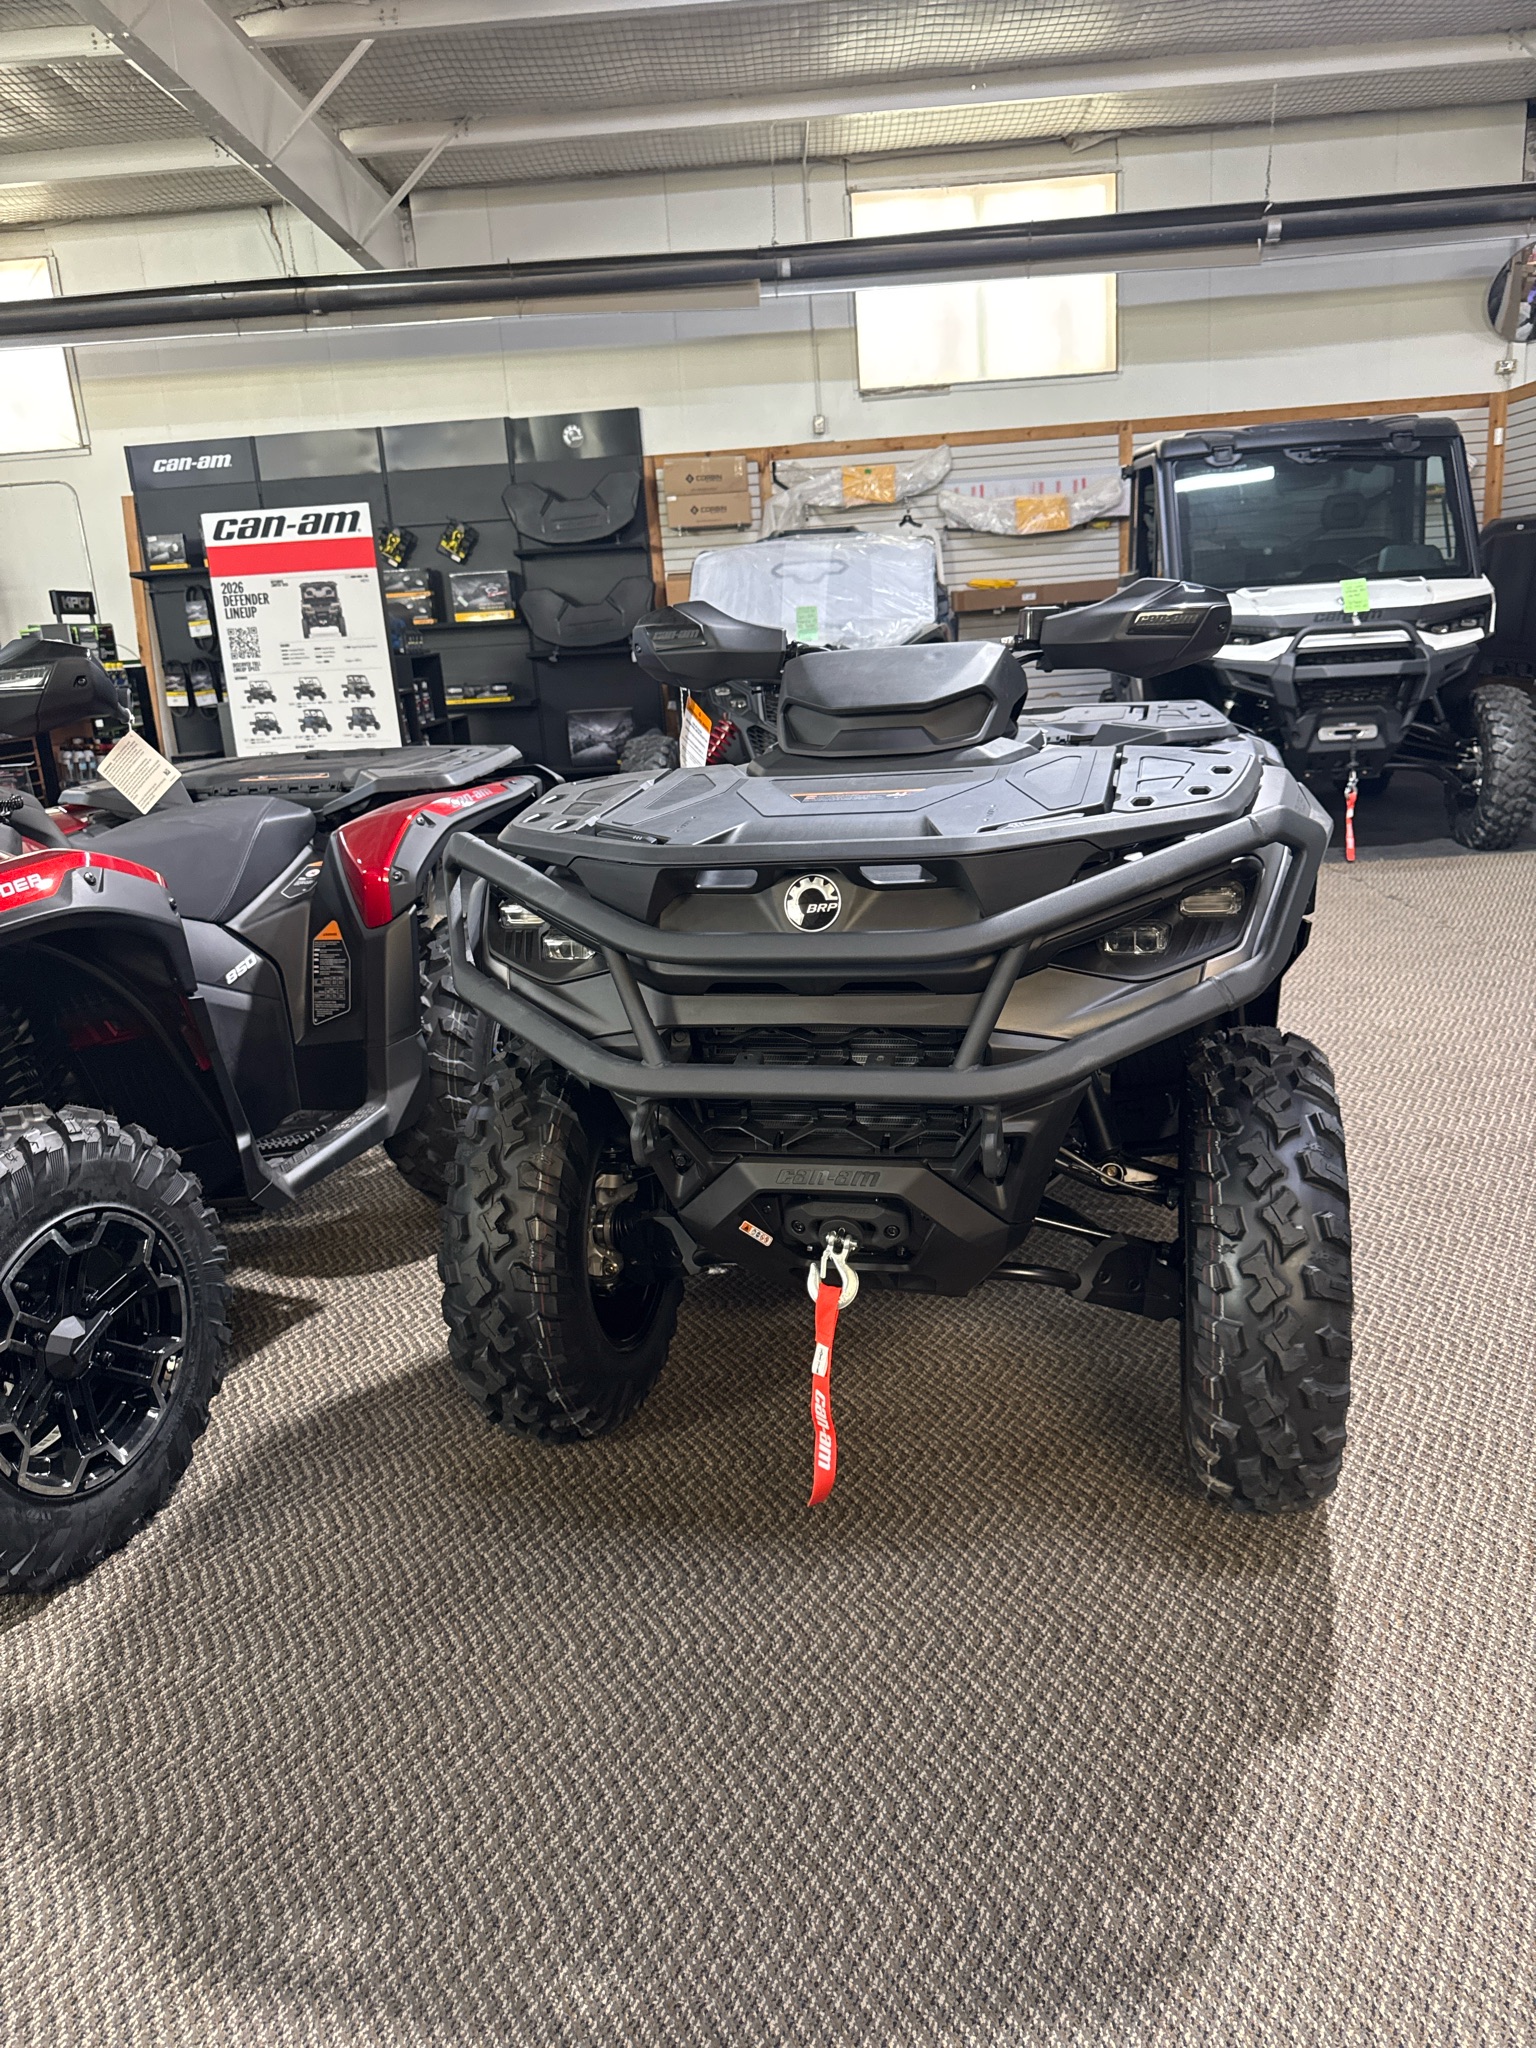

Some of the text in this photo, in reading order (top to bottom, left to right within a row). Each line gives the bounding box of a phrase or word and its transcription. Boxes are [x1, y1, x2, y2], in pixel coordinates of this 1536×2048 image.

[152, 454, 231, 473] can-am
[213, 510, 361, 541] can-am
[220, 582, 244, 594] 2026
[223, 593, 270, 607] DEFENDER
[224, 607, 257, 619] LINEUP
[652, 630, 699, 640] can-am
[806, 902, 838, 914] BRP
[225, 952, 257, 985] 850
[776, 1168, 881, 1188] can-am
[814, 1388, 832, 1471] can-am
